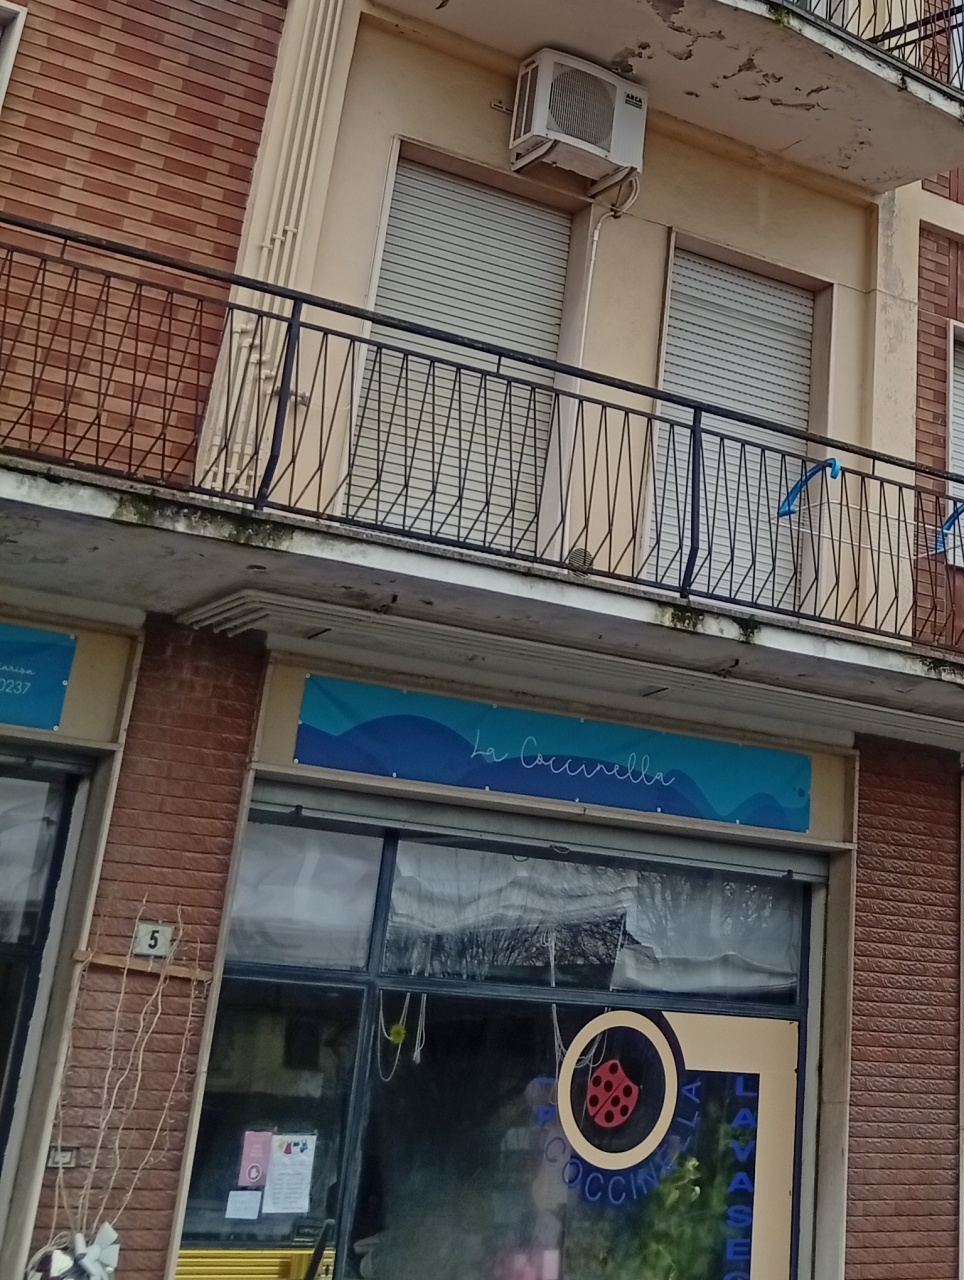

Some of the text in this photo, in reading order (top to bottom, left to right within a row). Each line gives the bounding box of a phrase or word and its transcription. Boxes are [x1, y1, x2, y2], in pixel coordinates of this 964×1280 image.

[0, 662, 35, 675] arisa
[470, 728, 676, 787] La Coccinella
[148, 929, 160, 949] 5
